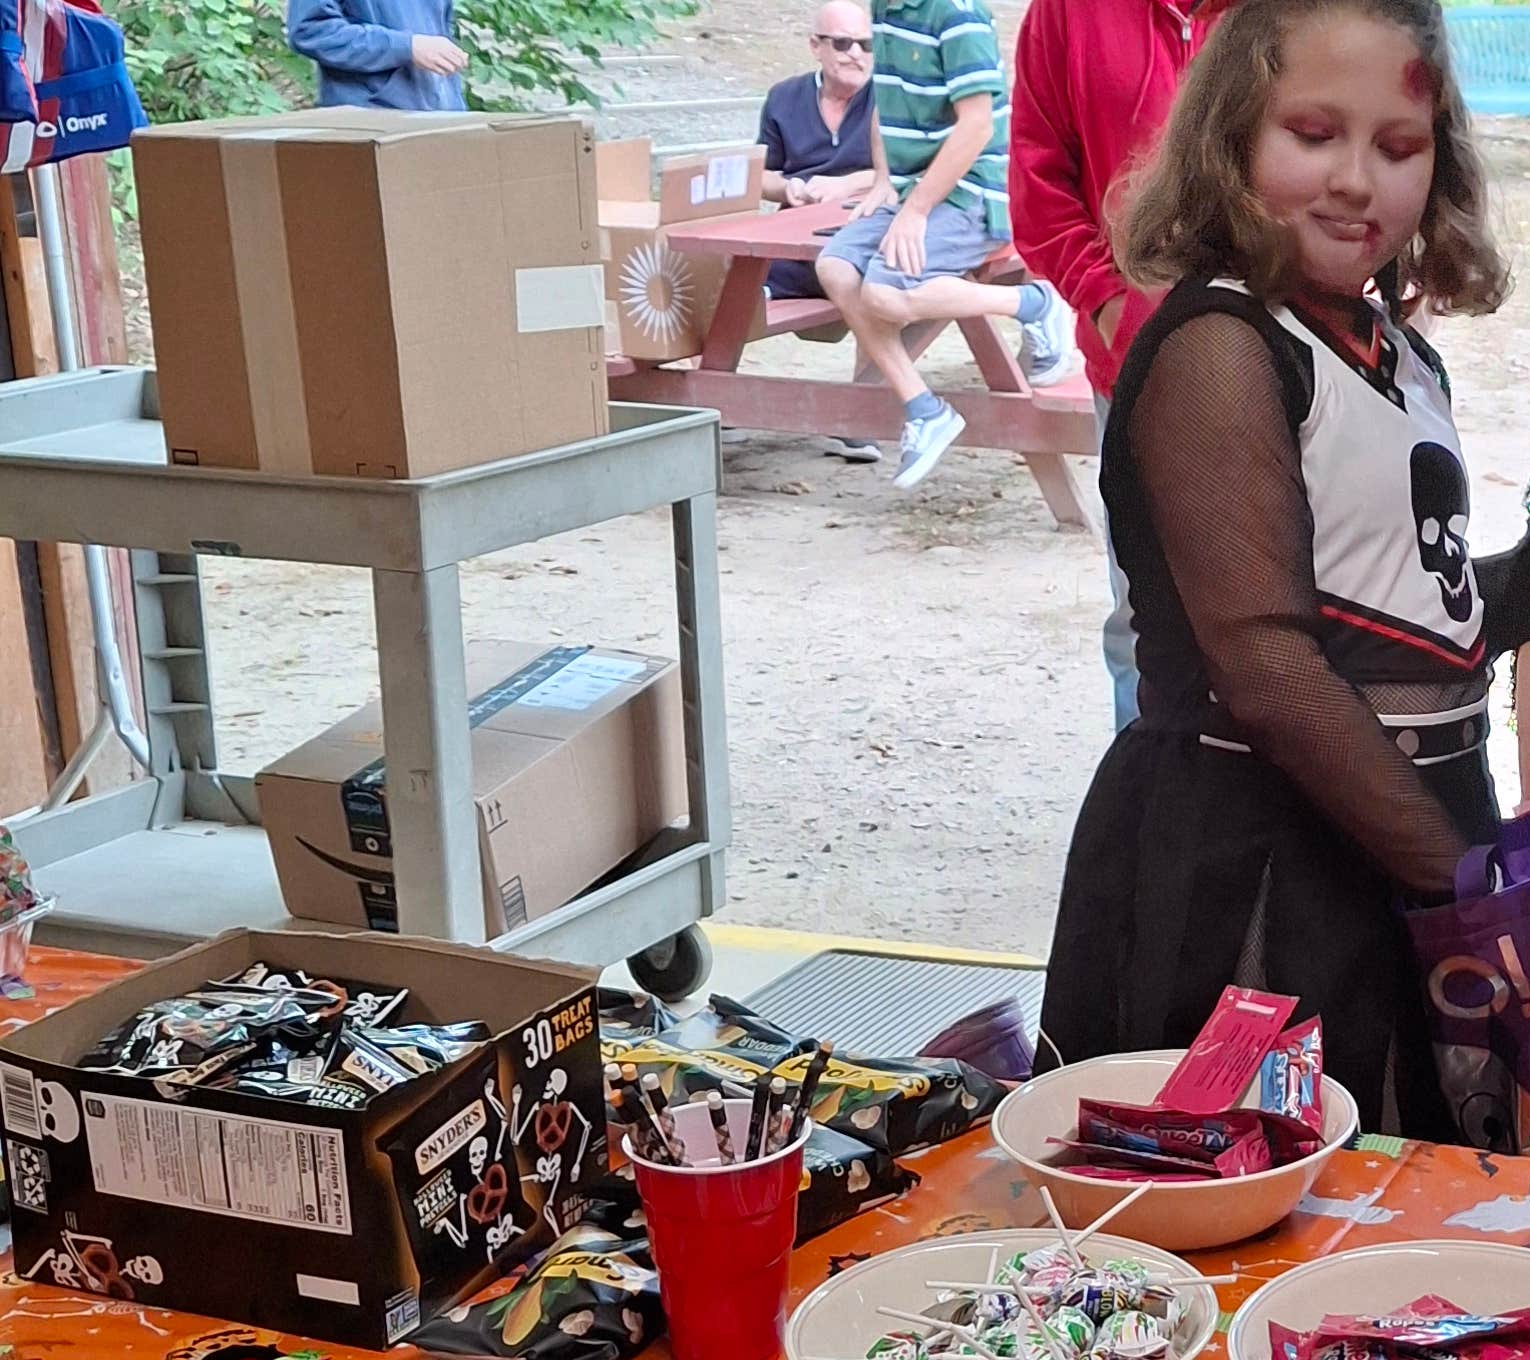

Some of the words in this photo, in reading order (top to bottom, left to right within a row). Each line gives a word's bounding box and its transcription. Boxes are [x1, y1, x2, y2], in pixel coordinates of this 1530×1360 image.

[66, 112, 108, 133] Onyx
[551, 994, 592, 1032] TREAT
[522, 1018, 554, 1069] 30
[554, 1016, 594, 1053] BAGS
[297, 1131, 309, 1175] Calories
[305, 1203, 316, 1223] 60
[326, 1135, 341, 1189] Nutrition
[333, 1191, 344, 1226] Facts
